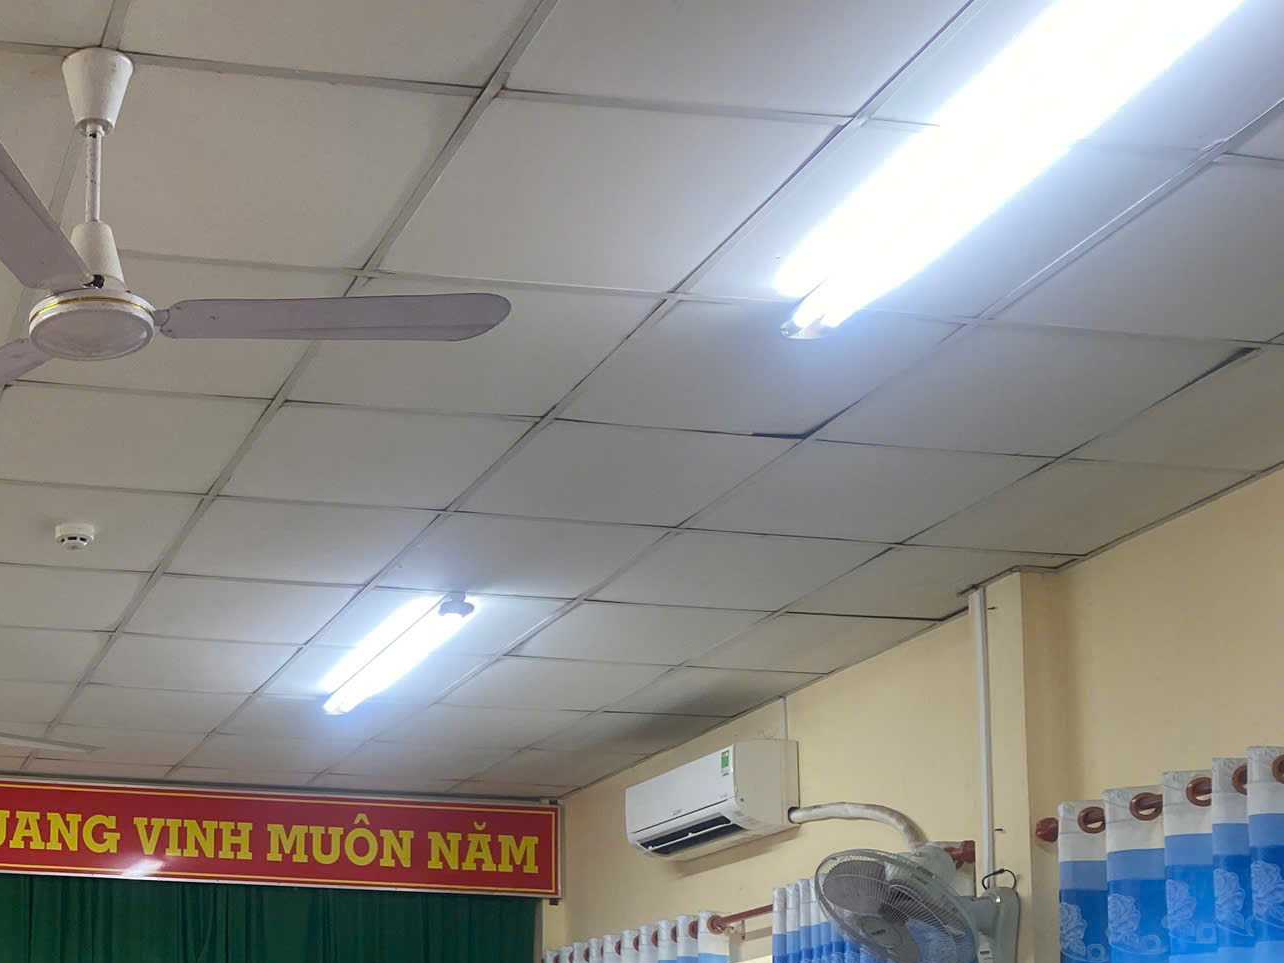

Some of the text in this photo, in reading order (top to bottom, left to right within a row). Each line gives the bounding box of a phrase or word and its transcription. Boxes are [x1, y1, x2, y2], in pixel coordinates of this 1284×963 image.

[133, 816, 253, 861] VINH
[265, 813, 414, 868] MUÔN
[427, 820, 540, 875] NĂM
